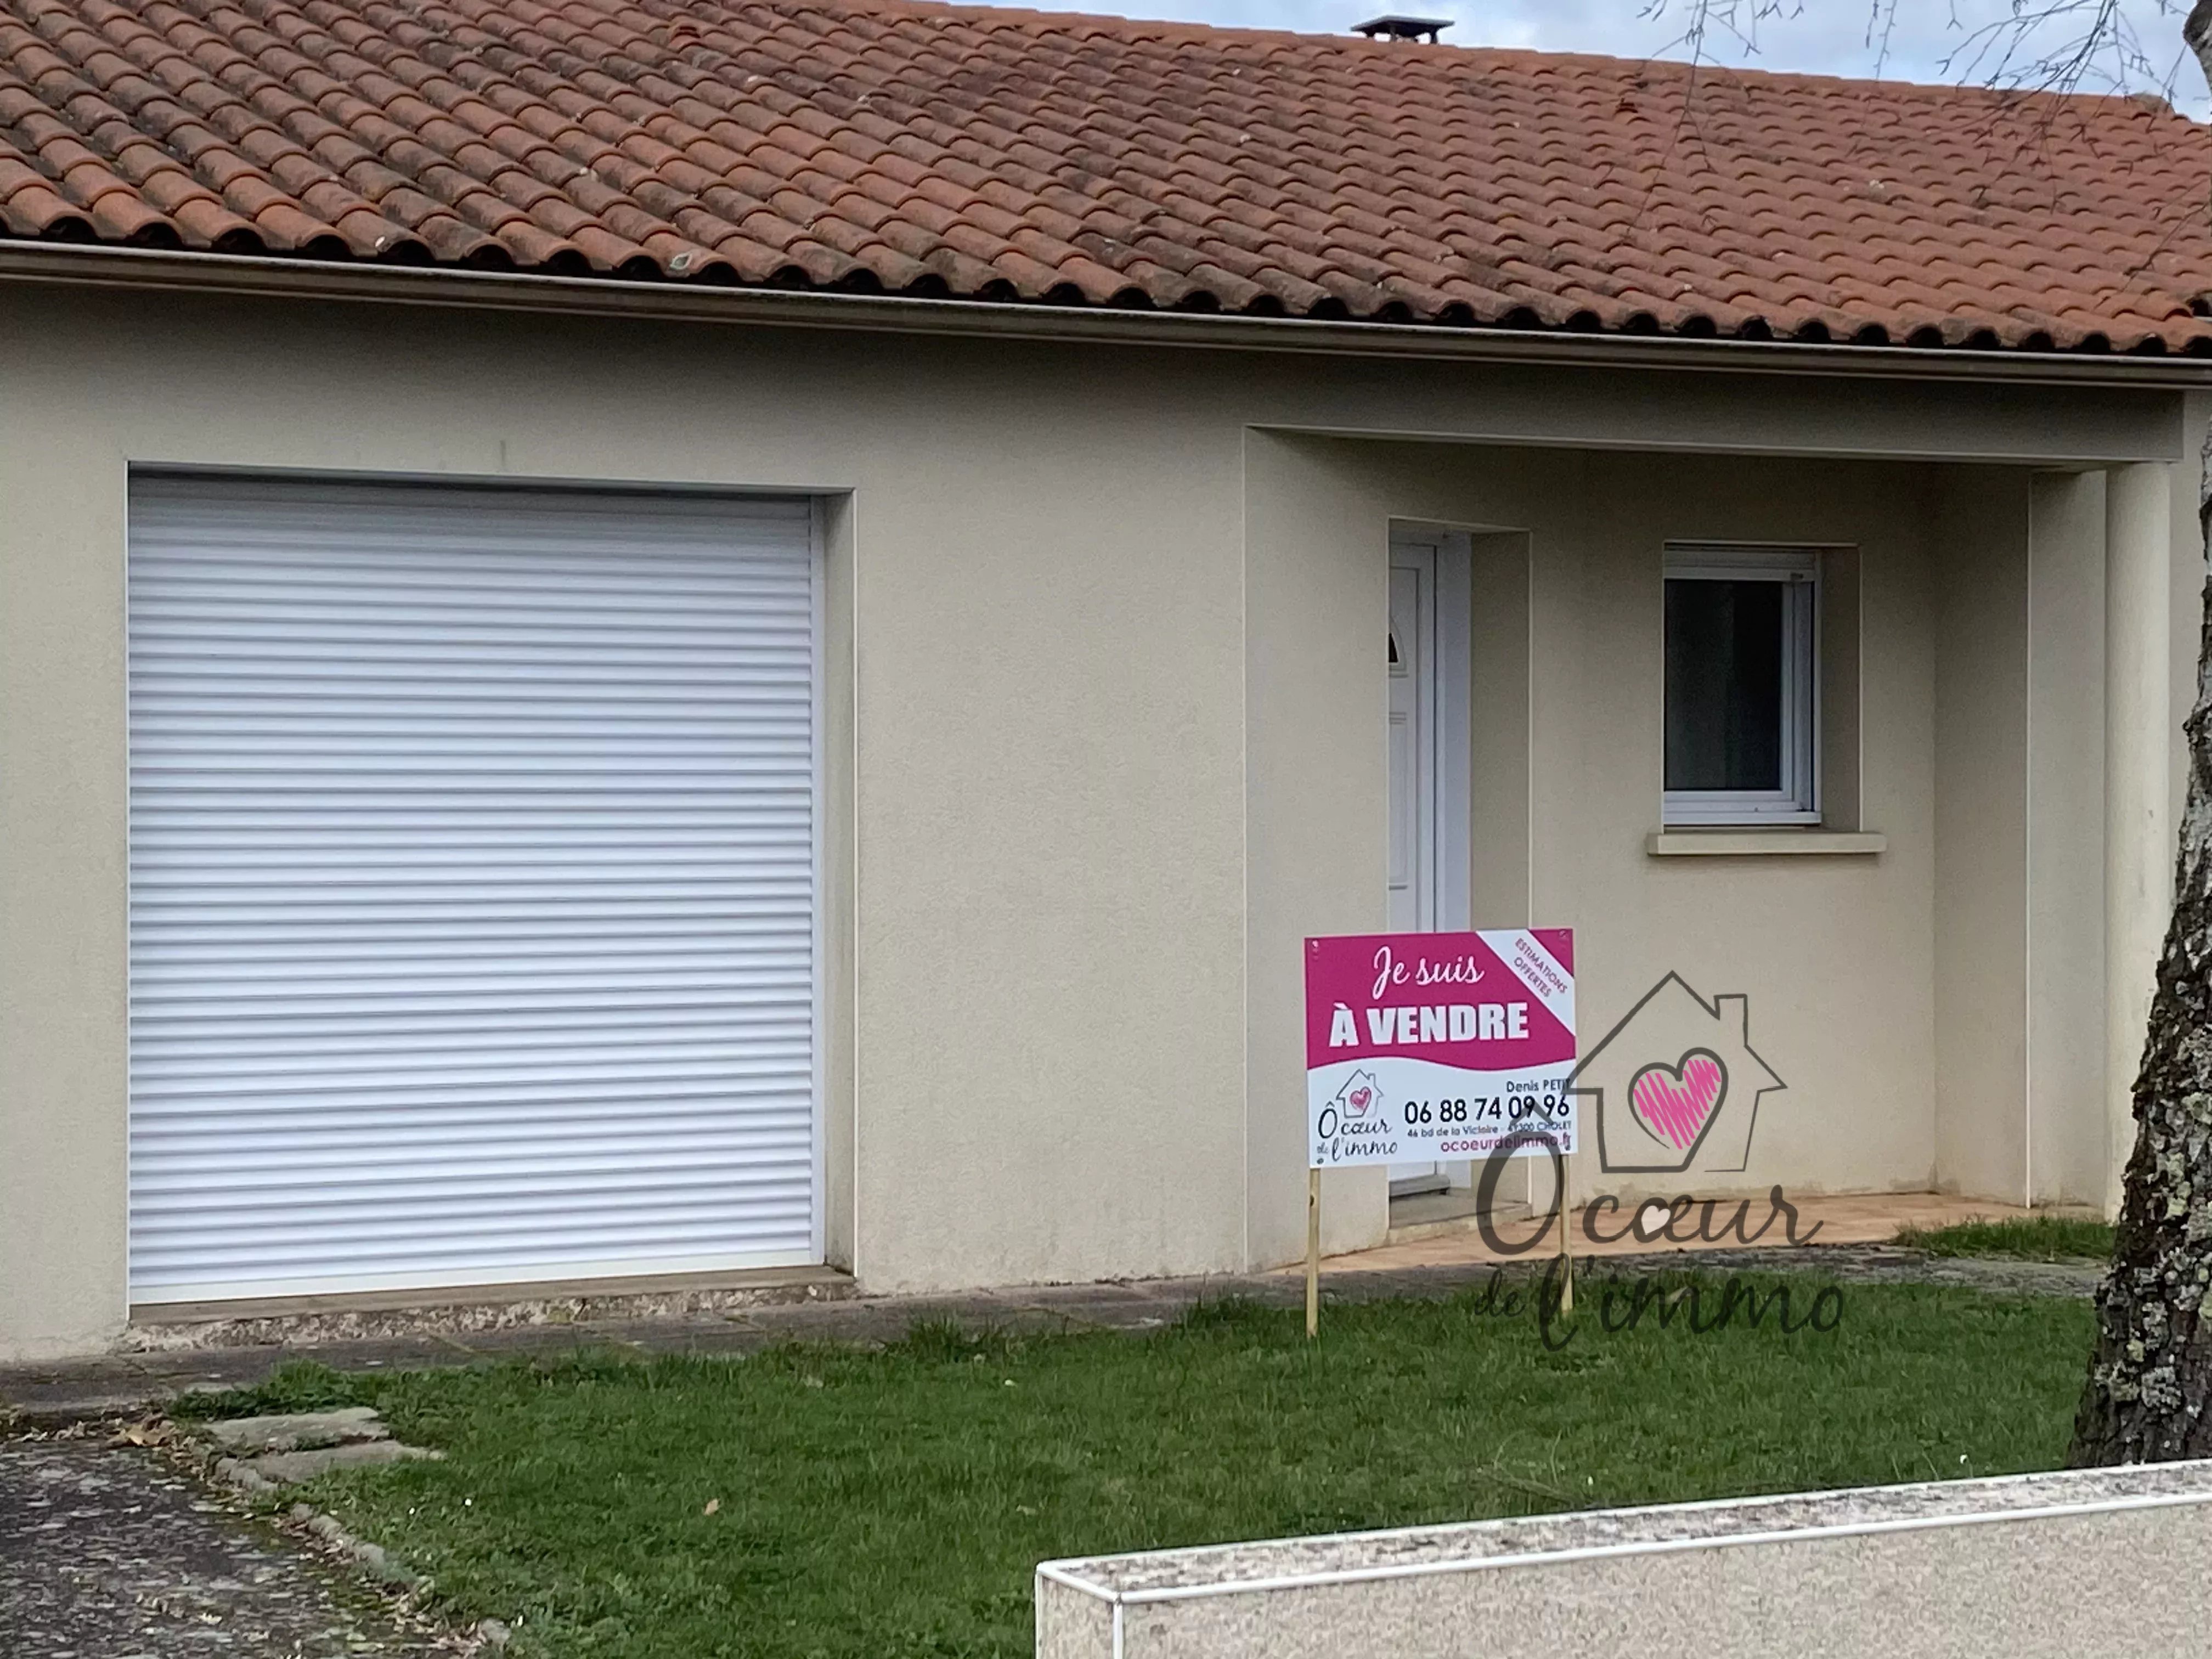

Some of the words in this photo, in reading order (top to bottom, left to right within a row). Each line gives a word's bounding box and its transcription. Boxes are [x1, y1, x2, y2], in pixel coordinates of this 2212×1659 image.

[1372, 945, 1410, 1000] Je
[1415, 956, 1485, 985] suis
[1514, 957, 1552, 998] OFFERTES
[1515, 938, 1567, 994] ESTIMATIONS
[1329, 1003, 1359, 1047] À
[1366, 1002, 1529, 1045] VENDRE
[1506, 1080, 1539, 1092] Denis
[1404, 1101, 1432, 1124] 06
[1440, 1099, 1467, 1122] 88
[1475, 1097, 1502, 1120] 74
[1508, 1096, 1536, 1119] 09
[1543, 1094, 1570, 1116] 96
[1436, 1127, 1449, 1136] de
